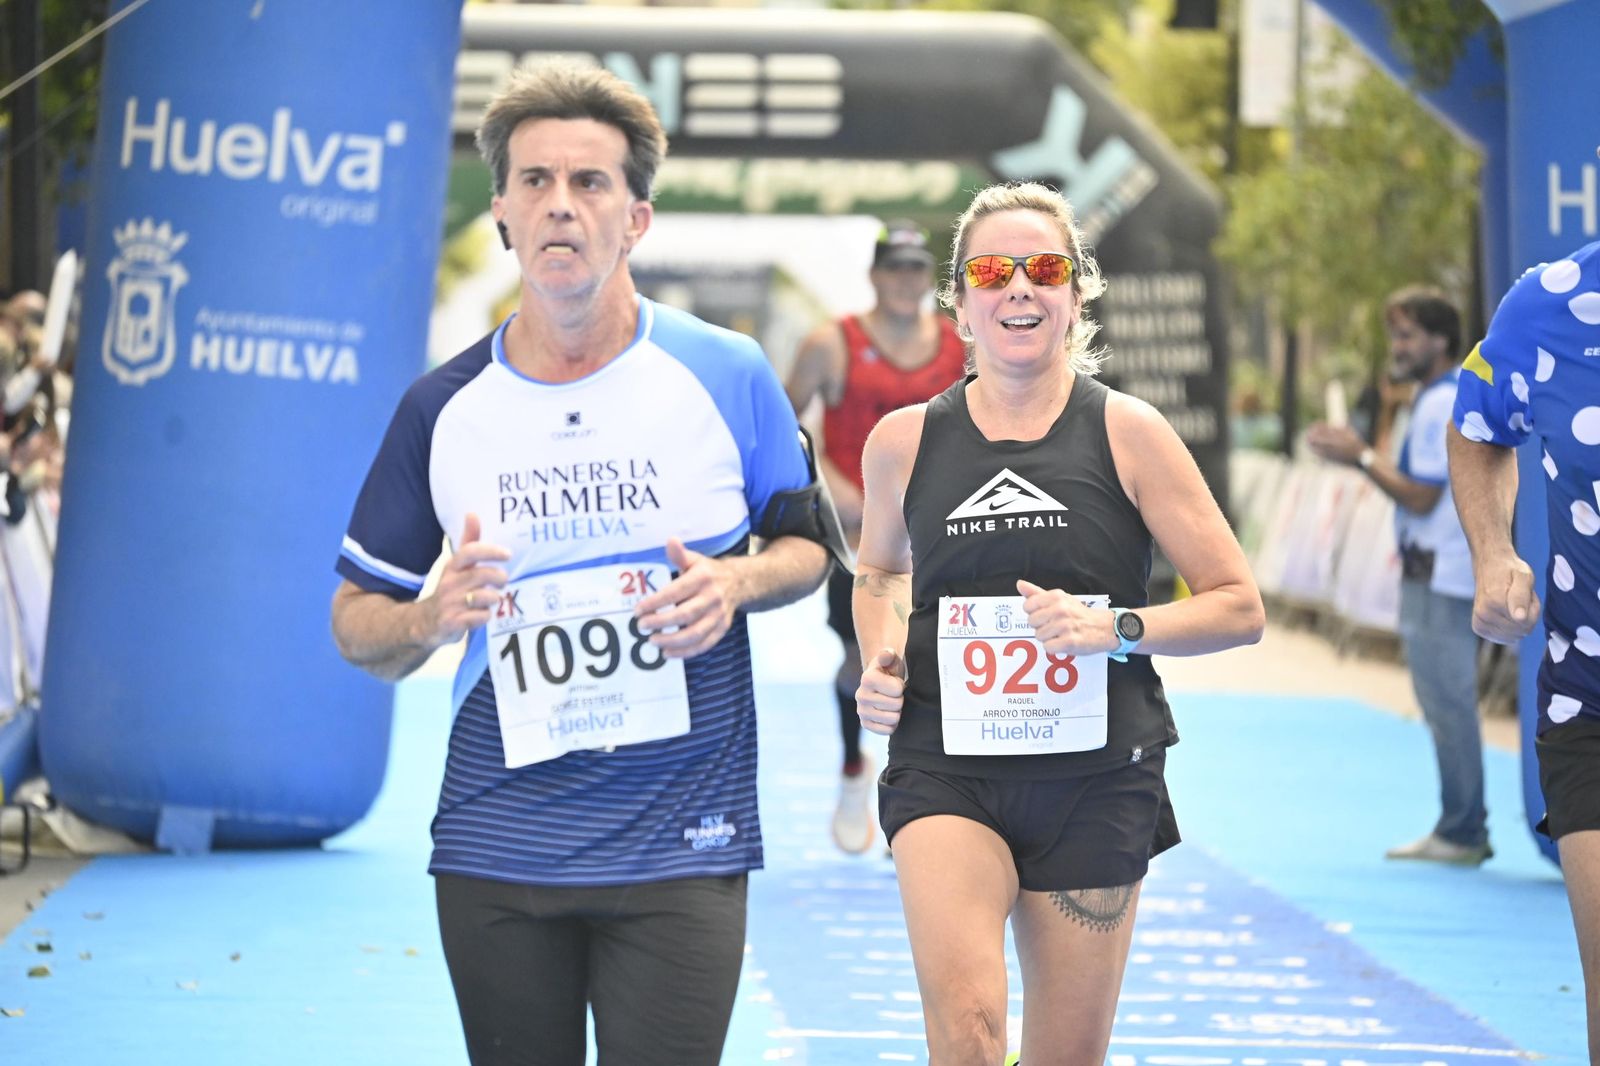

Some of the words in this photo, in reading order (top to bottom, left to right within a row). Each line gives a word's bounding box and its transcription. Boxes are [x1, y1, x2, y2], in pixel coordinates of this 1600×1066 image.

[120, 97, 385, 192] Huelva
[190, 332, 360, 386] HUELVA
[498, 460, 619, 493] RUNNERS
[630, 458, 658, 479] LA
[500, 483, 661, 523] PALMERA
[946, 520, 996, 536] NIKE
[1005, 515, 1068, 529] TRAIL
[619, 569, 658, 596] 21K
[949, 603, 977, 627] 21K
[947, 627, 977, 636] HUELVA
[500, 615, 668, 694] 1098
[963, 640, 1079, 695] 928
[983, 709, 1018, 718] ARROYO
[1021, 708, 1061, 718] TORONJO
[1007, 697, 1035, 705] RAQUEL
[547, 710, 624, 740] Huelva
[981, 721, 1054, 740] Huelva
